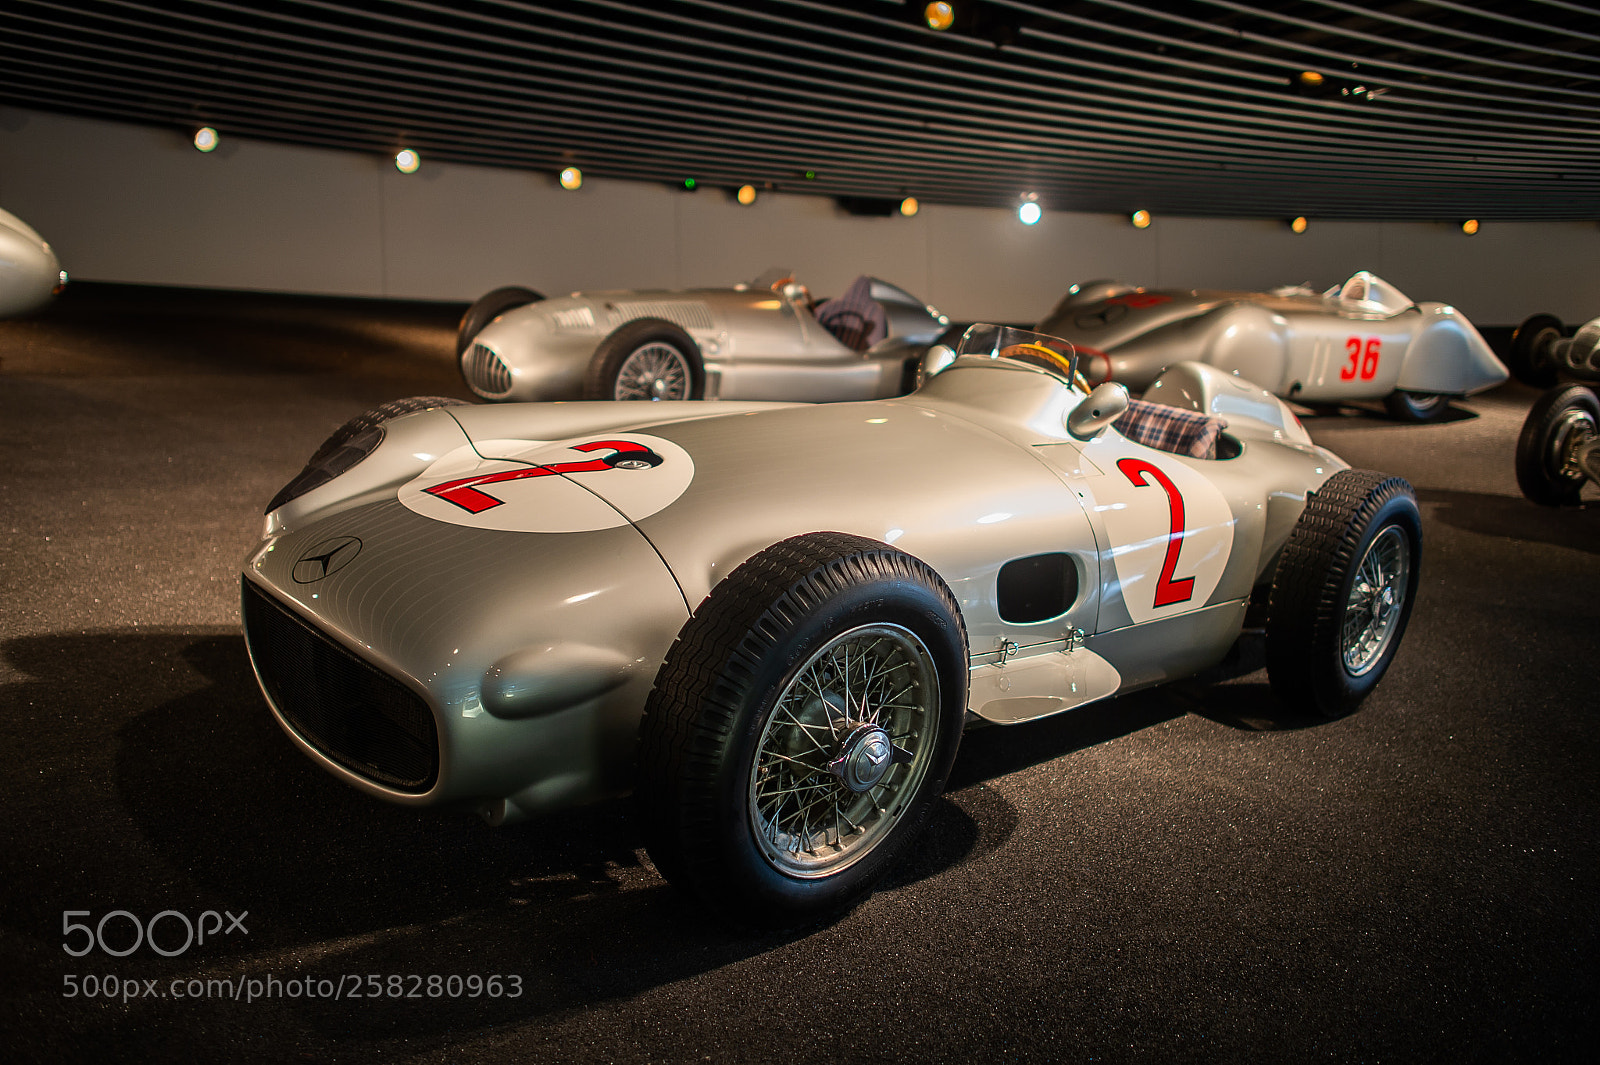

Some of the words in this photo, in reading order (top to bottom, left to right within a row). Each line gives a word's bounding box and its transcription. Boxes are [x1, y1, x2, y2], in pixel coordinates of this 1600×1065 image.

[1340, 335, 1382, 382] 36
[420, 439, 654, 514] 2
[1116, 457, 1196, 609] 2
